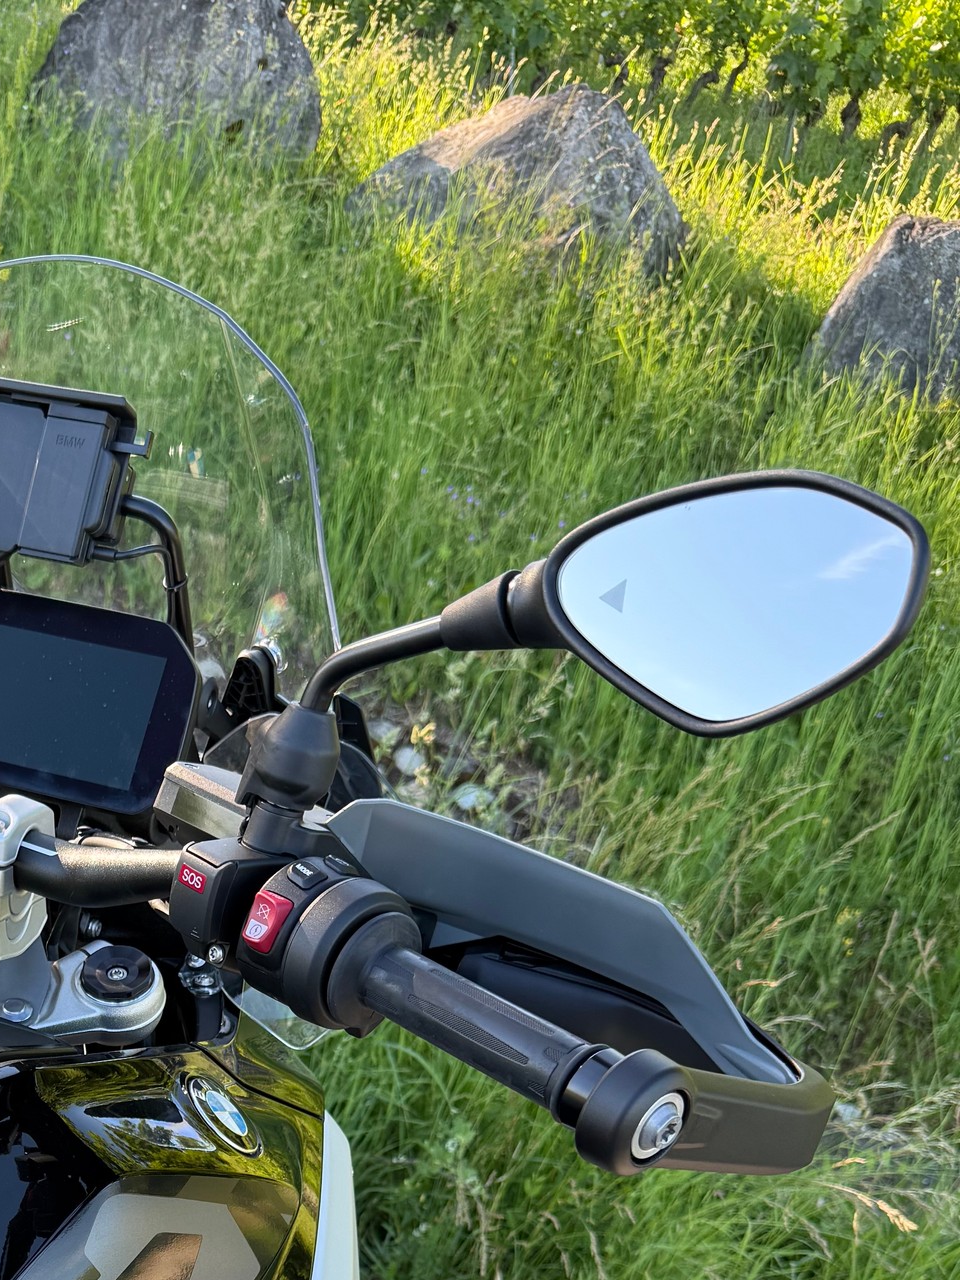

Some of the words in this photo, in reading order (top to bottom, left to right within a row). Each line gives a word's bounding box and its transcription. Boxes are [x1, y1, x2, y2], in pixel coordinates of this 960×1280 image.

[56, 434, 86, 448] BMW
[295, 863, 313, 876] MODE
[182, 869, 202, 889] SOS
